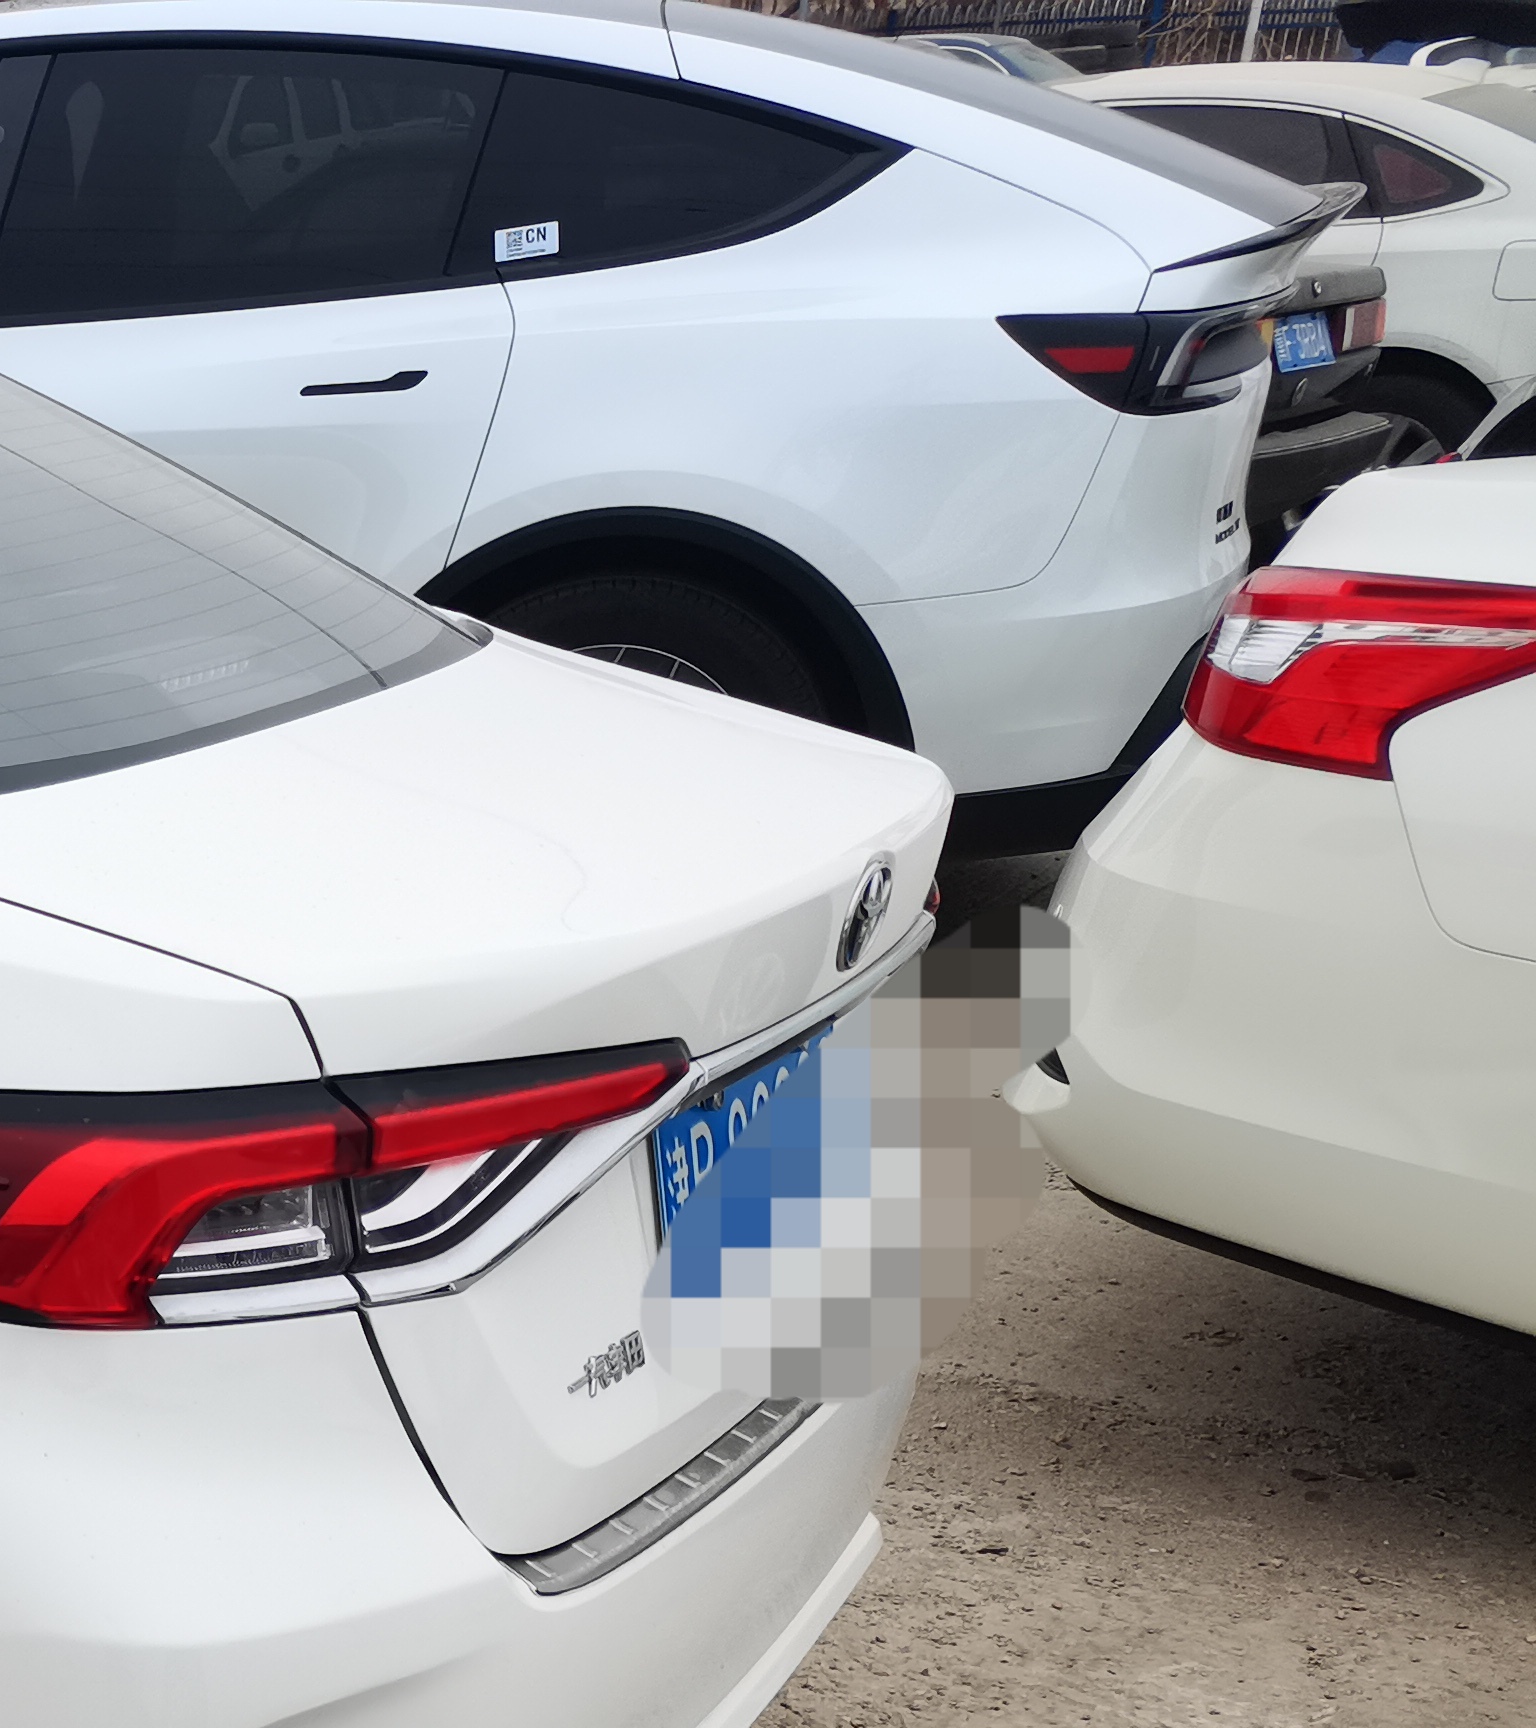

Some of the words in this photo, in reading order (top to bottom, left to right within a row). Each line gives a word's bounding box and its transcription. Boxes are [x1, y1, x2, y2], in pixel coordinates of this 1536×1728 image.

[525, 225, 547, 244] CN
[566, 1329, 646, 1399] 一汽丰田
